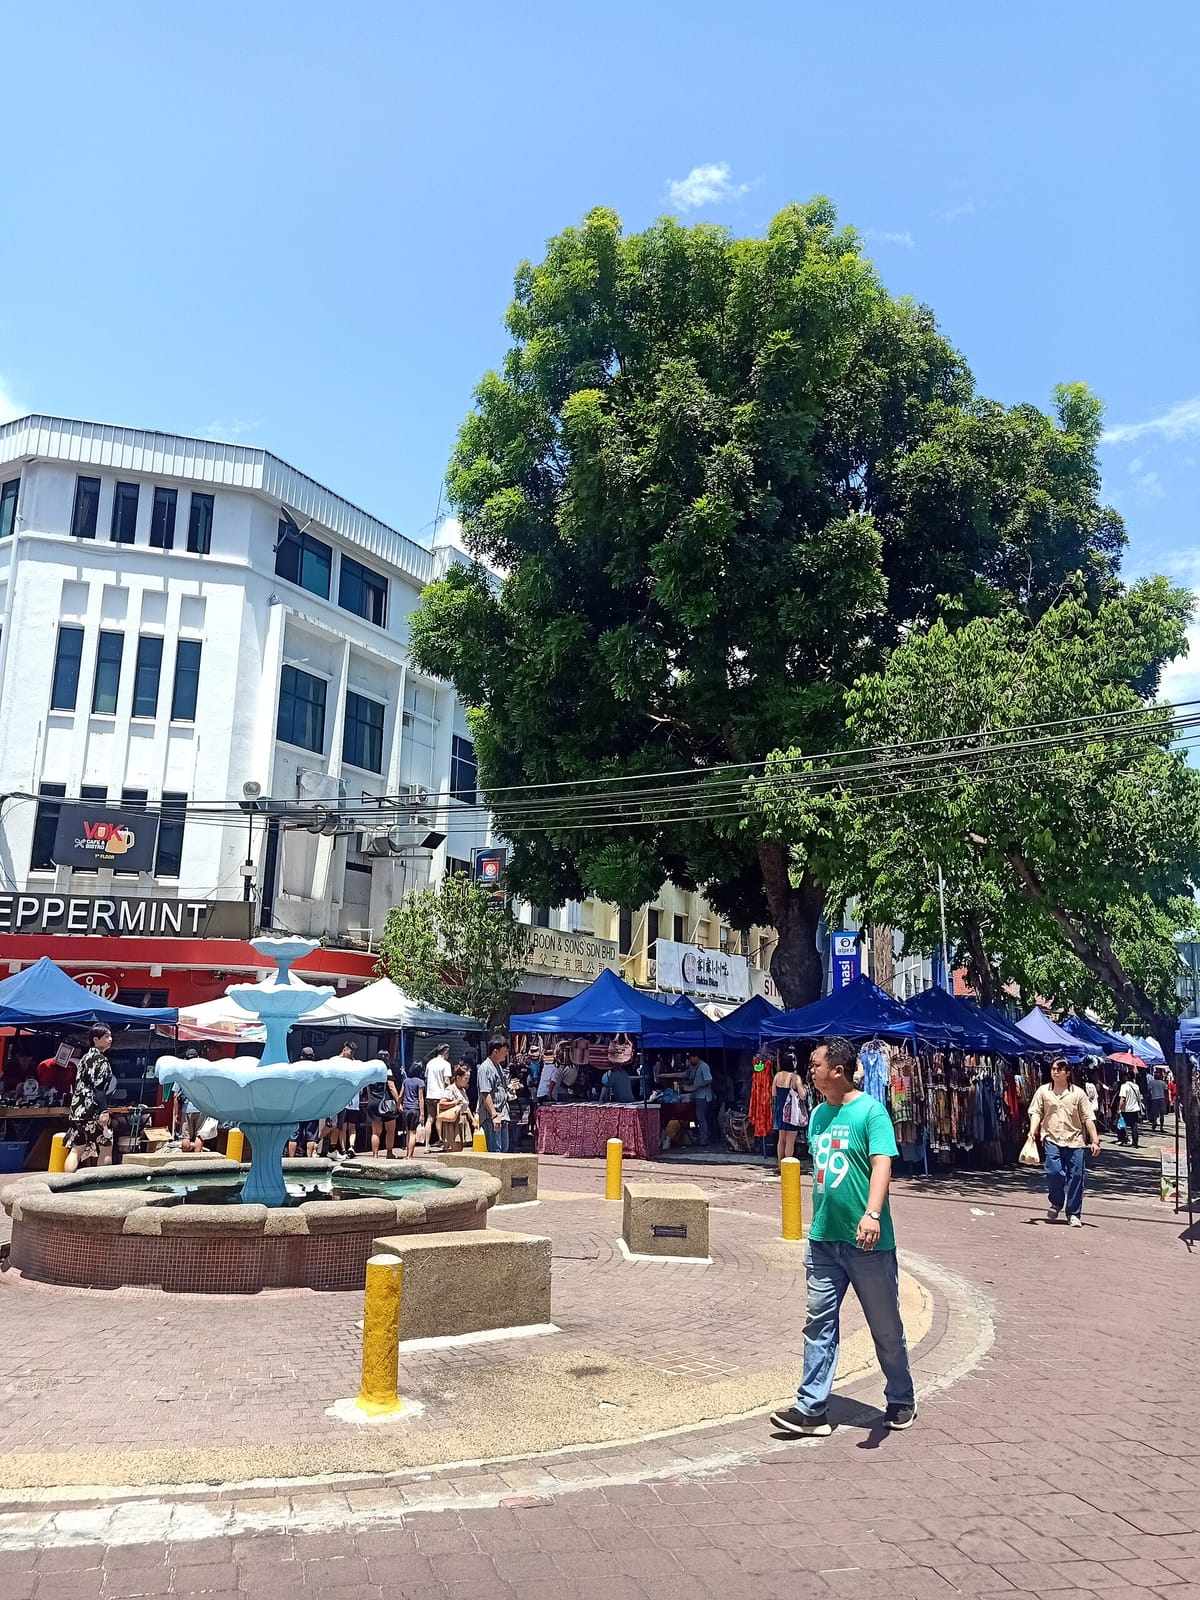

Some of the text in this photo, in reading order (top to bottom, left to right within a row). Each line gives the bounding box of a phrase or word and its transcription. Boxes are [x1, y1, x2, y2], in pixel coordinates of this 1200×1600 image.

[533, 932, 556, 951] BOON
[557, 937, 562, 951] &
[564, 938, 584, 956] SONS
